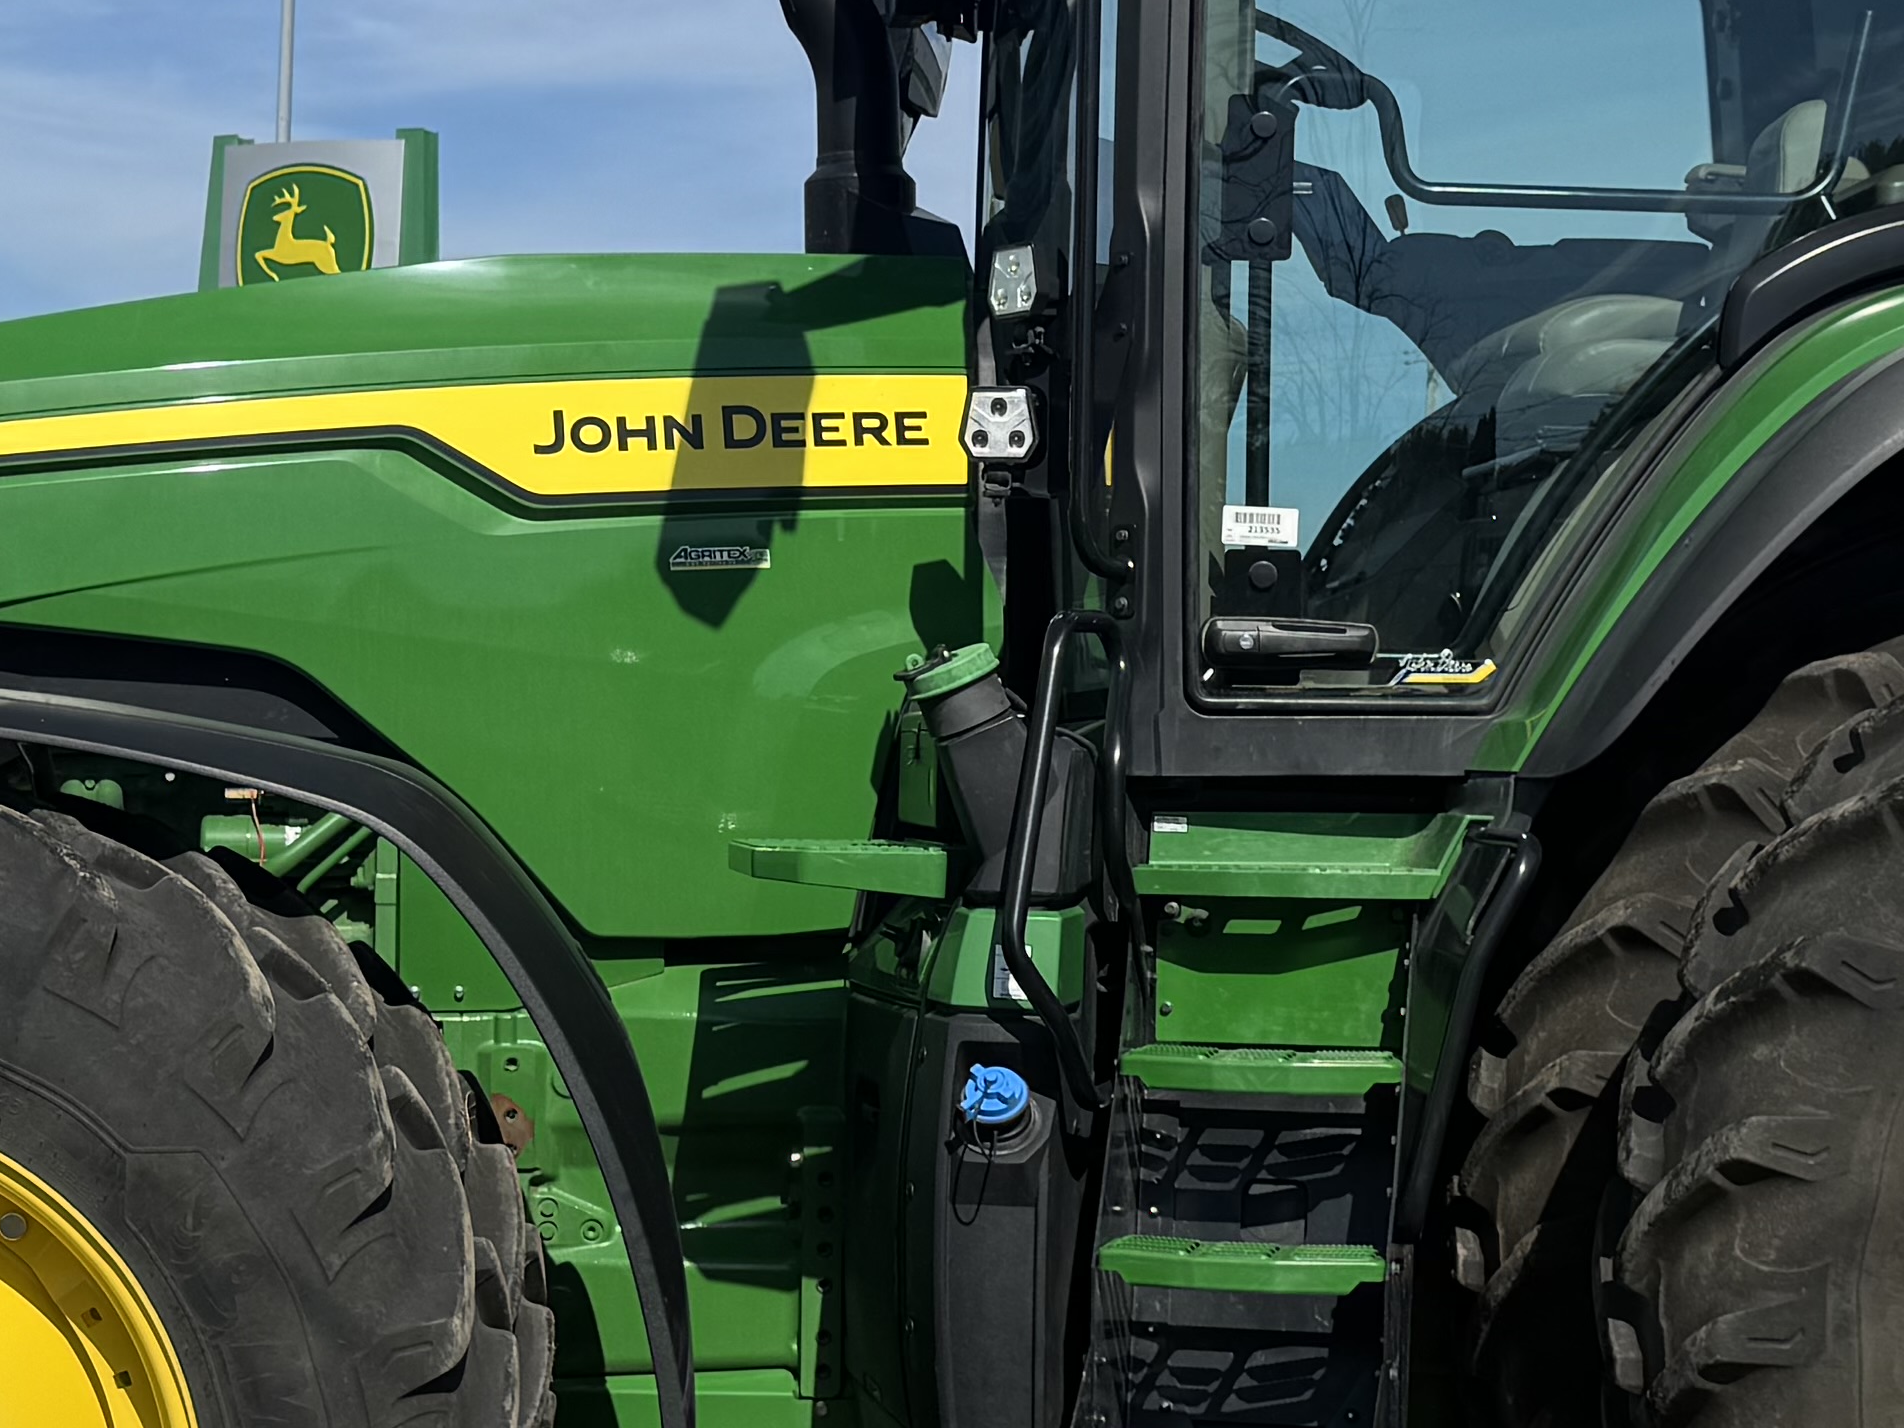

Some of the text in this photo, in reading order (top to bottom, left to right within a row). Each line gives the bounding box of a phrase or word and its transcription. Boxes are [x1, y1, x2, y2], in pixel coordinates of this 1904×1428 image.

[532, 405, 930, 455] JOHN DEERE
[673, 547, 749, 561] AGRITEX
